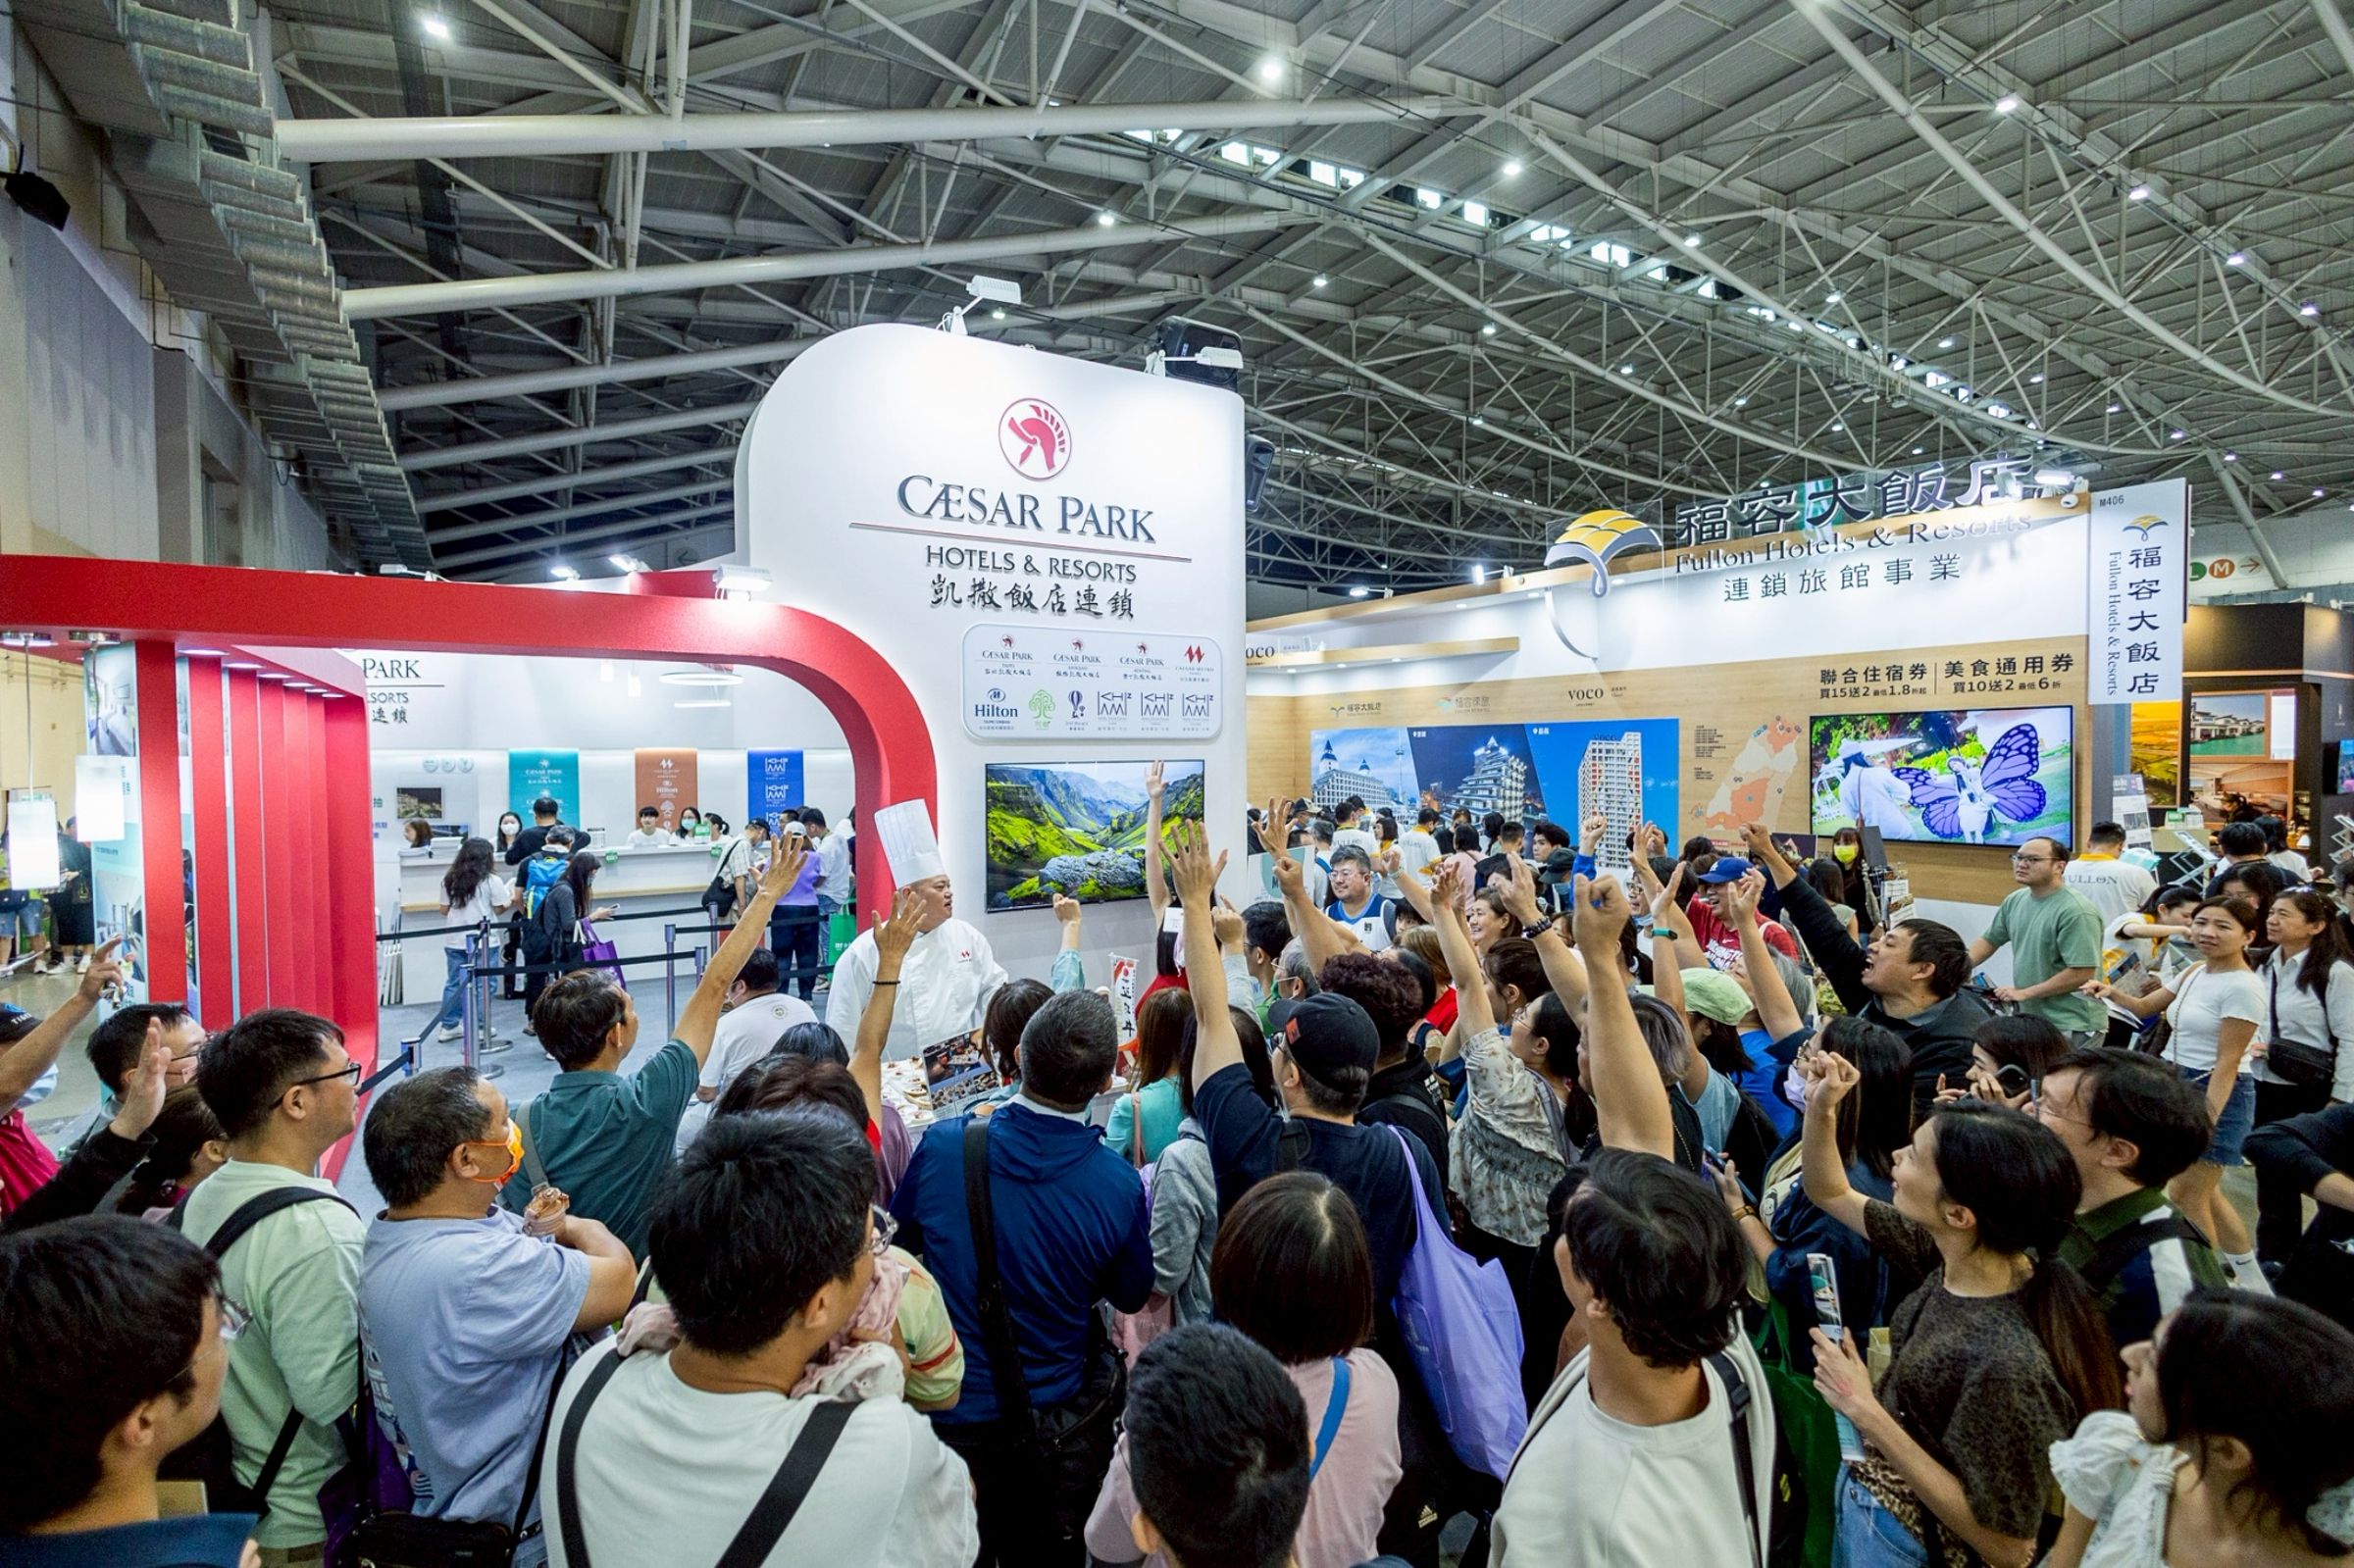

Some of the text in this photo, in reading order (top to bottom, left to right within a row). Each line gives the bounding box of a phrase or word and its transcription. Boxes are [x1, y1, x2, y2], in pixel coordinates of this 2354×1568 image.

[1675, 450, 2033, 546] 福容大飯店
[2099, 495, 2124, 507] M406
[1057, 495, 1156, 543] PARK
[1676, 516, 2032, 574] Fullon Hotels & Resorts
[926, 545, 1137, 582] HOTELS & RESORTS
[2214, 564, 2229, 576] M
[1724, 553, 1961, 602] 連鎖旅館事業
[931, 573, 1135, 618] 凱撒飯店連鎖
[2107, 551, 2122, 695] Fullon Hotels & Resorts
[2125, 546, 2162, 693] 福容大飯店
[1246, 646, 1275, 659] oco
[363, 658, 422, 679] PARK
[1820, 663, 1927, 685] 聯合住宿券
[1944, 653, 2073, 679] 美食通用券
[367, 692, 409, 704] SORTS
[975, 704, 1018, 717] Hilton
[2064, 873, 2118, 885] ULLON
